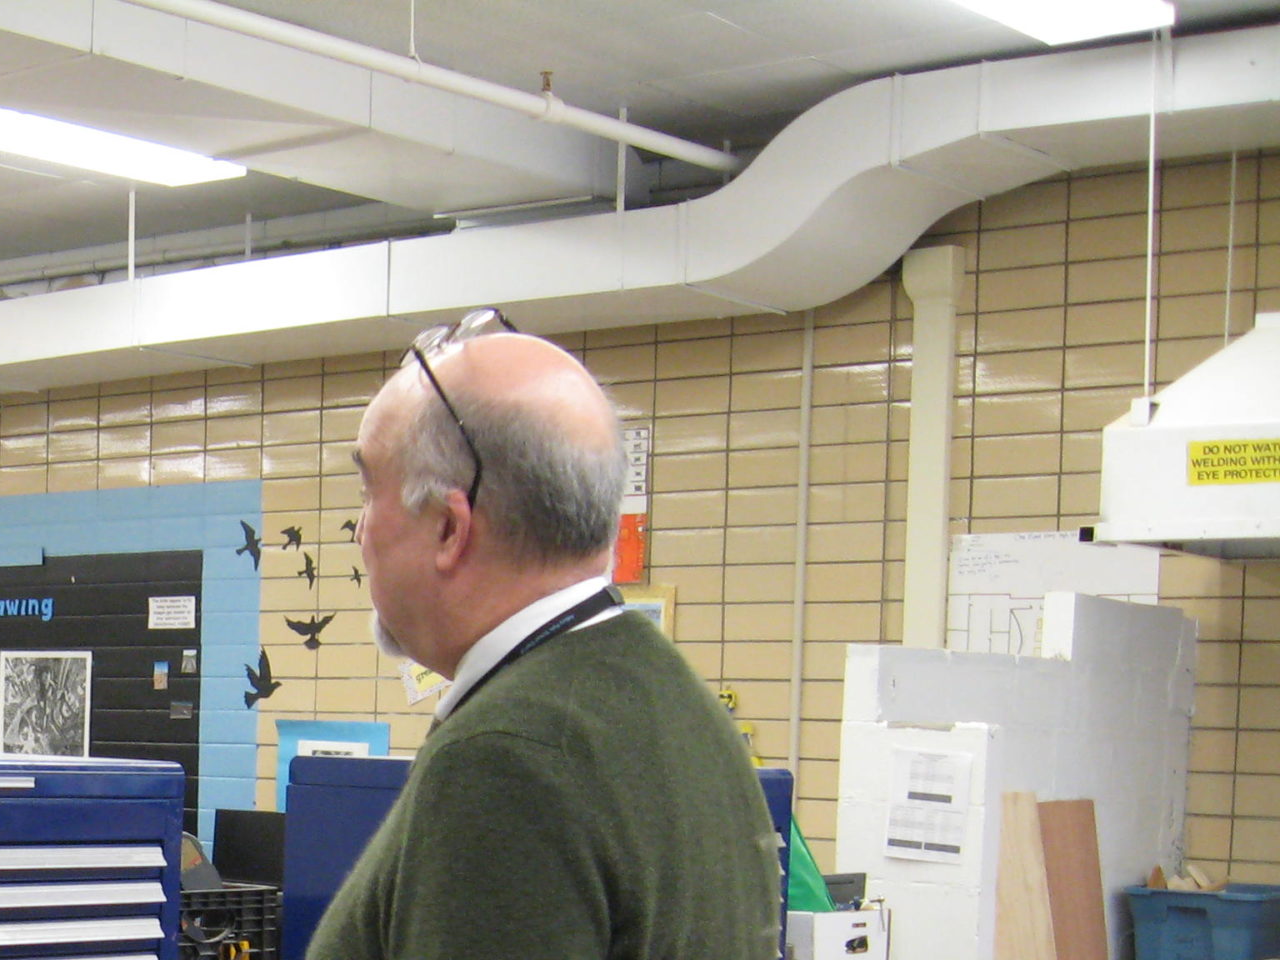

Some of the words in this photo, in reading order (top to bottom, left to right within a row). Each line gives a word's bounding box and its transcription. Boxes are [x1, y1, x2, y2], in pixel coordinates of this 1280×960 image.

[1203, 445, 1220, 455] DO
[1224, 444, 1248, 454] NOT
[1191, 457, 1247, 468] WELDING
[1198, 471, 1219, 480] EYE
